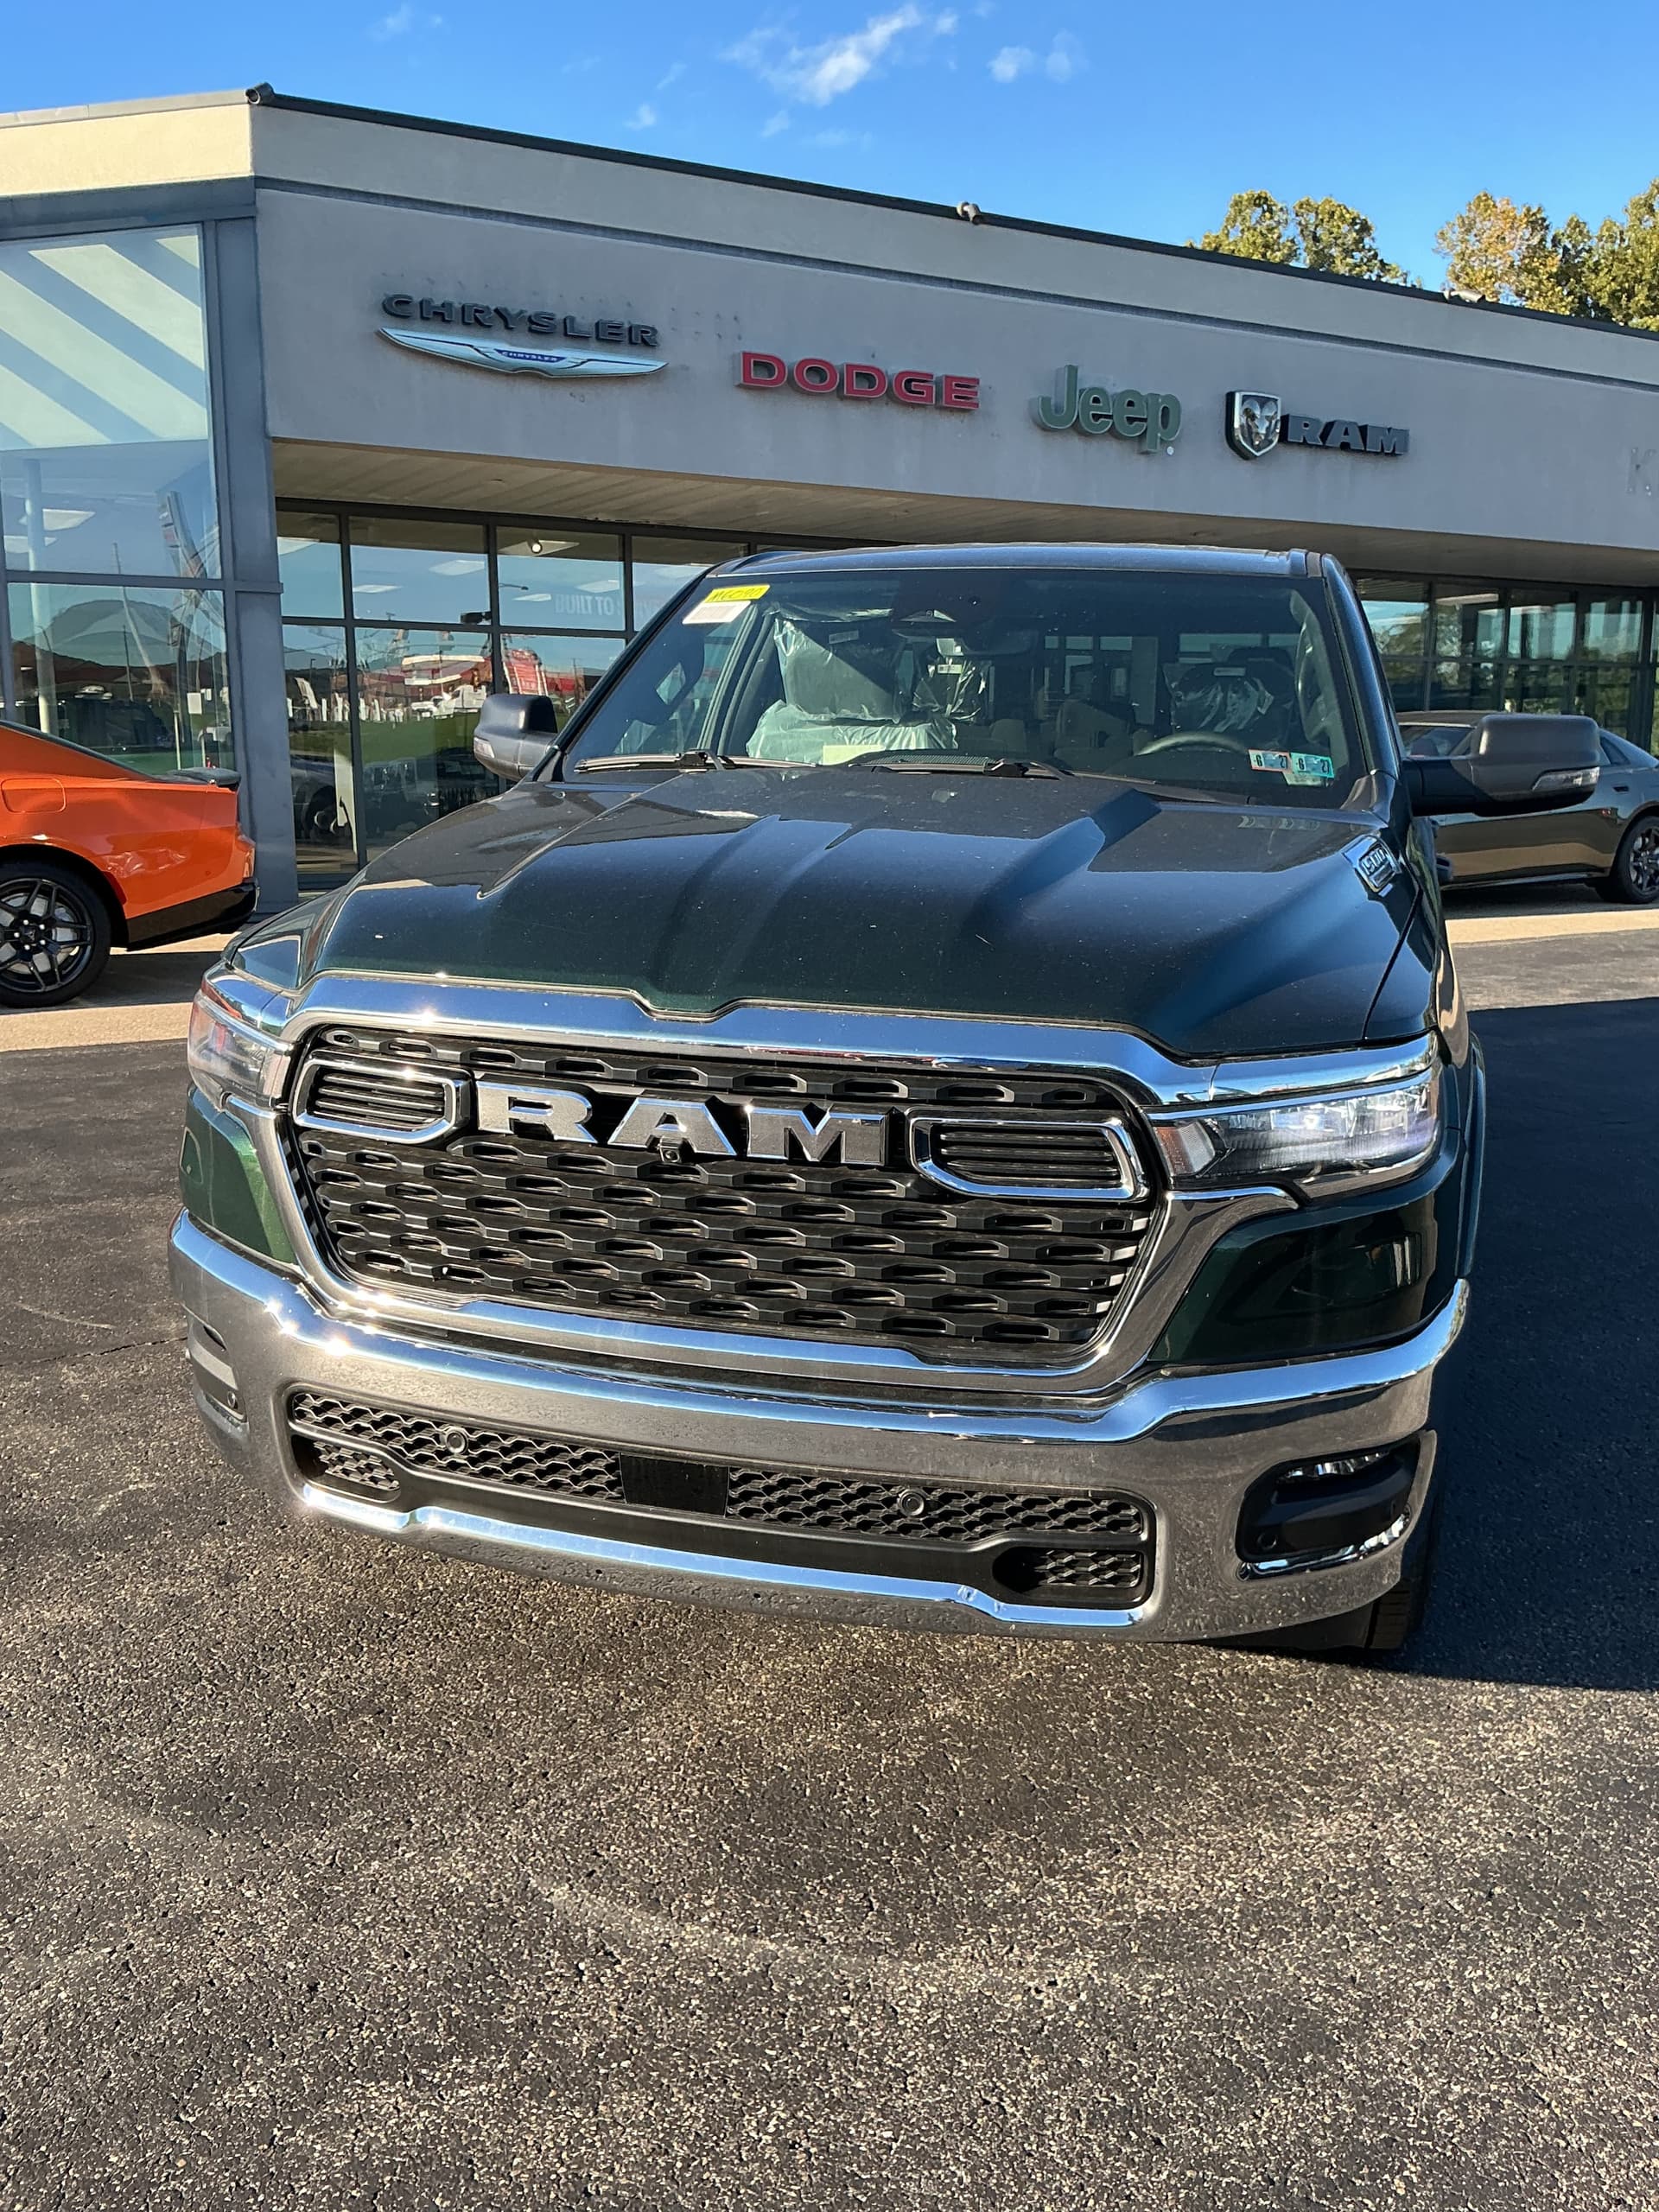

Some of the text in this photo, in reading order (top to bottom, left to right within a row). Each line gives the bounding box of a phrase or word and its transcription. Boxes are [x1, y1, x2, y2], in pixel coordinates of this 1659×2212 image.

[381, 293, 659, 346] CHRYSLER
[736, 350, 981, 410] DODGE
[1035, 364, 1181, 454] Jeep
[1284, 413, 1410, 455] RAM
[555, 594, 592, 614] BUILT
[595, 596, 614, 616] TO
[476, 1080, 886, 1166] RAM
